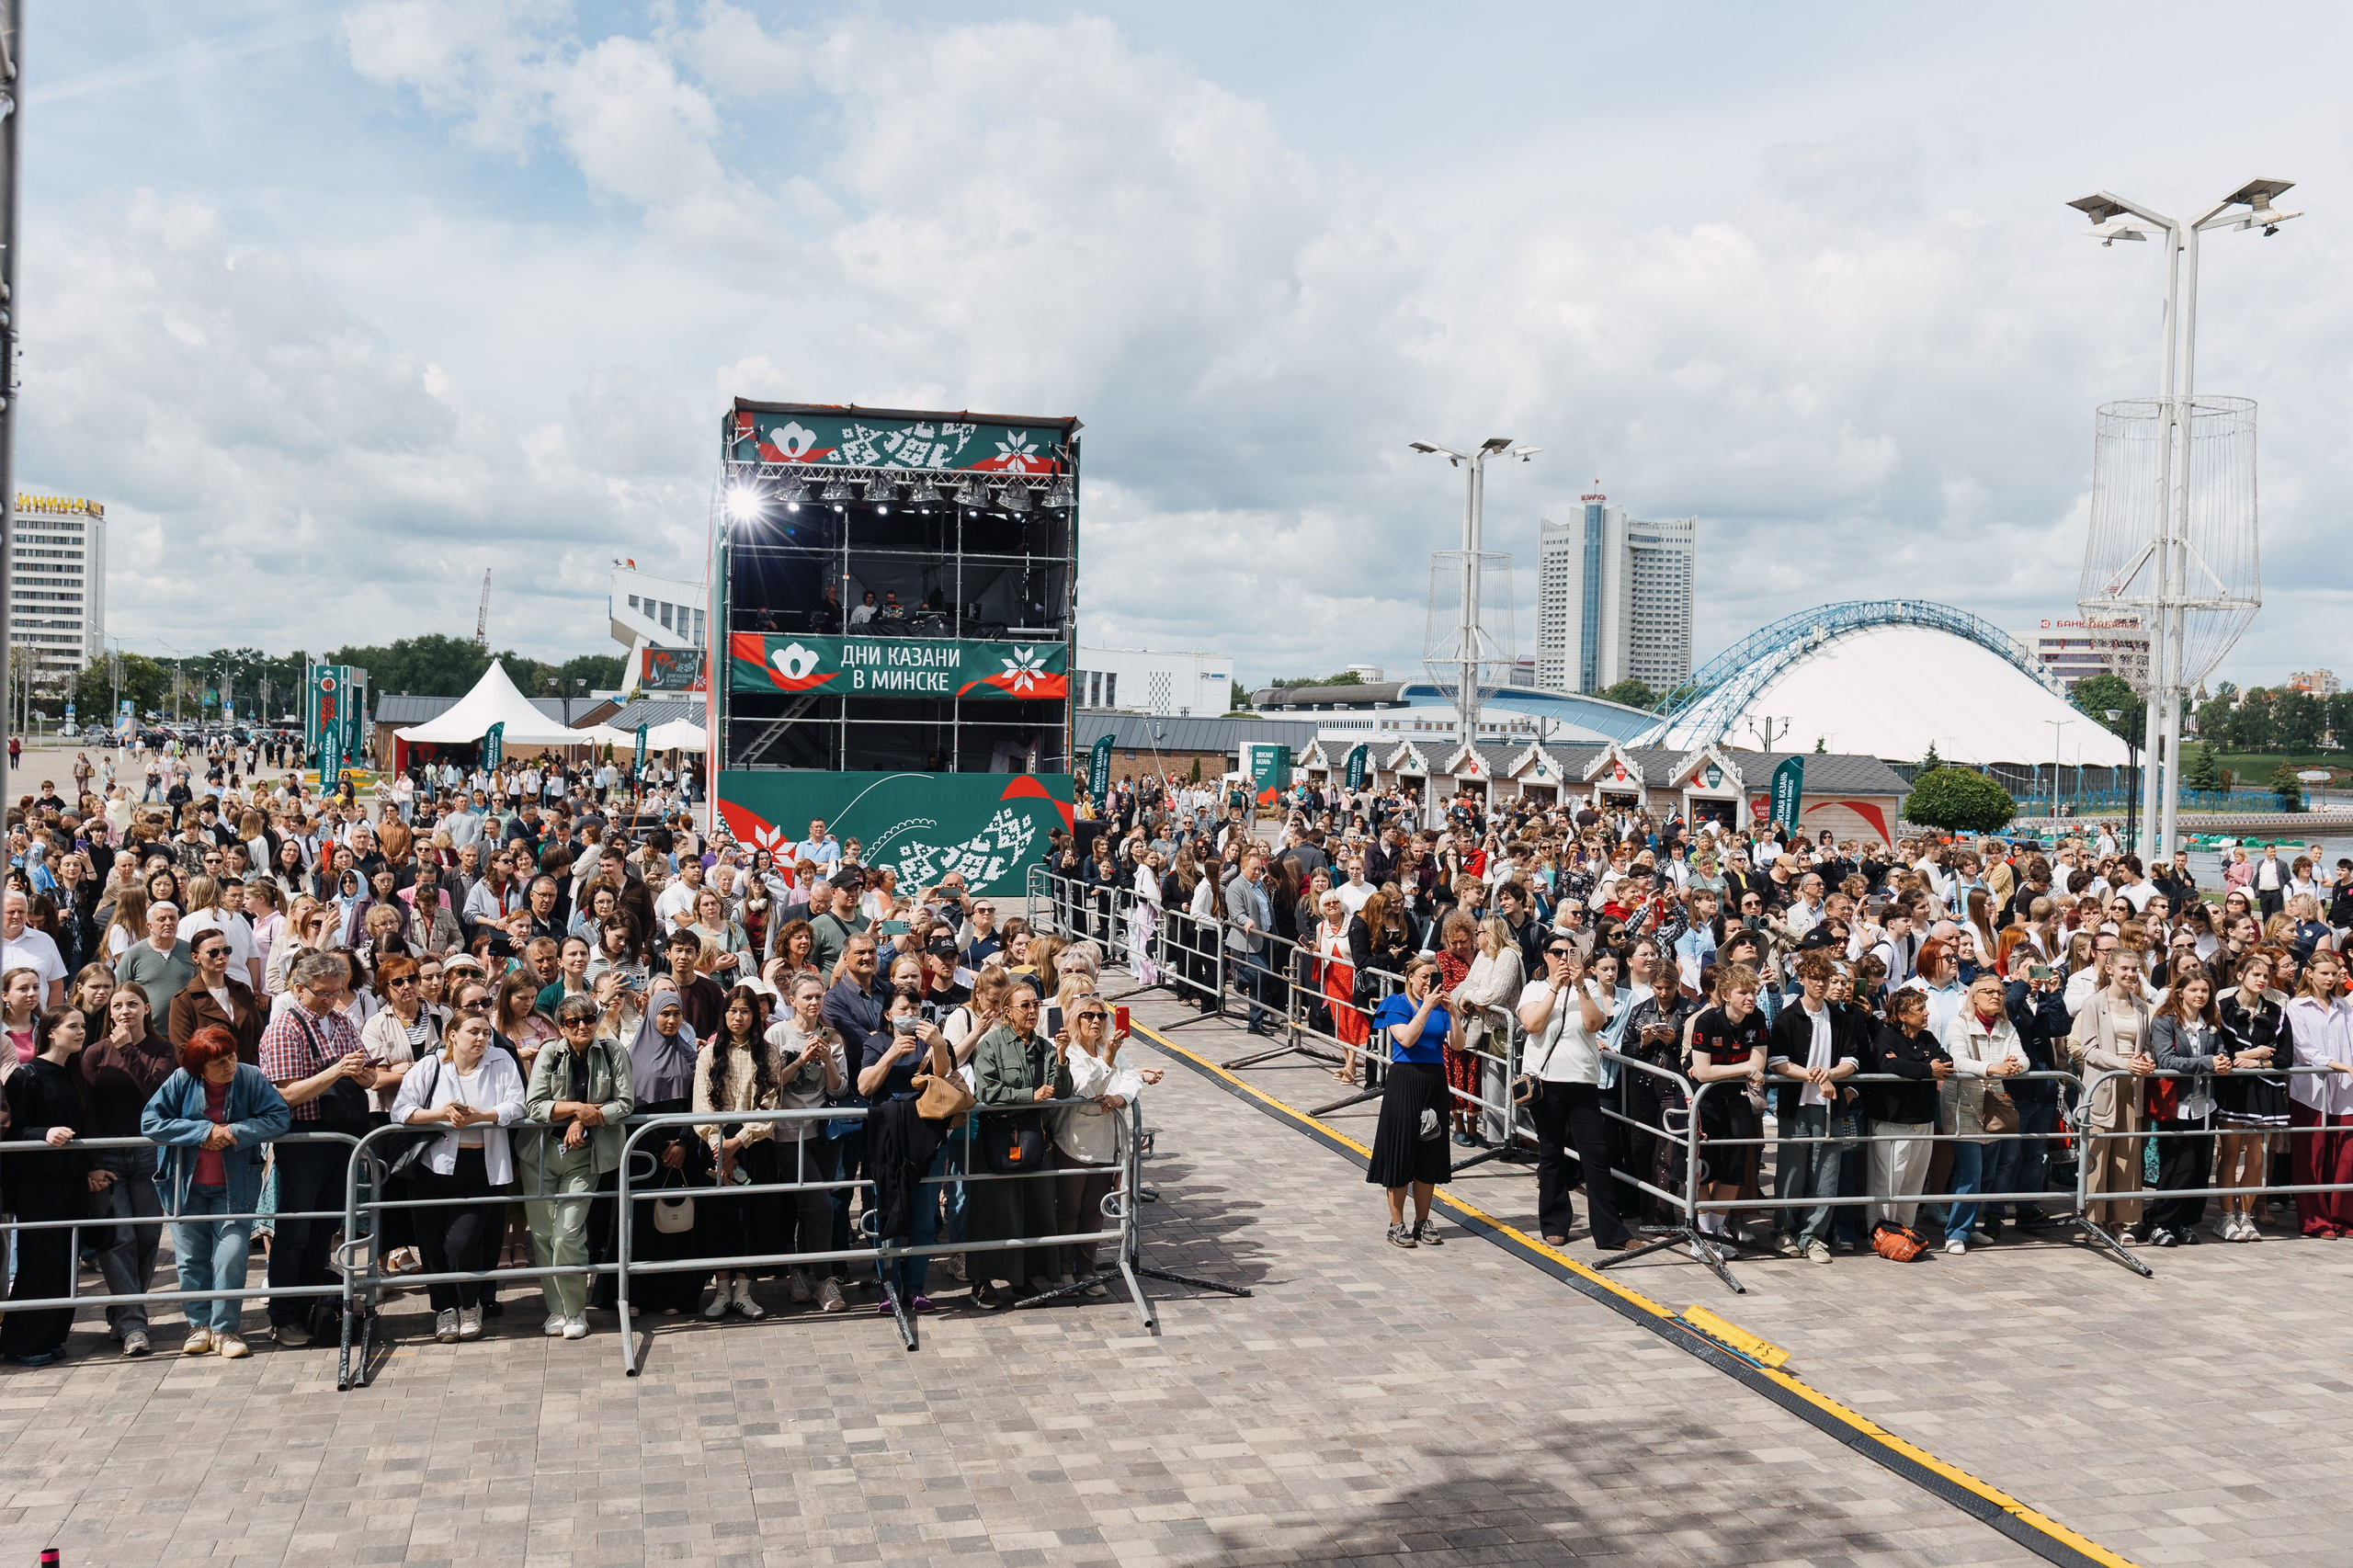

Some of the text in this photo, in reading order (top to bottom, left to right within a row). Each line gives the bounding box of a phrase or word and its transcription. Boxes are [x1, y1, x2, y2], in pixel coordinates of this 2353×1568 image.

[2056, 619, 2085, 628] БАНК
[840, 644, 961, 667] ДНИ КАЗАНИ
[853, 669, 949, 691] В МИНСКЕ
[1777, 772, 1788, 823] УСНАЯ КАЗАНЬ
[1692, 1032, 1703, 1044] 13
